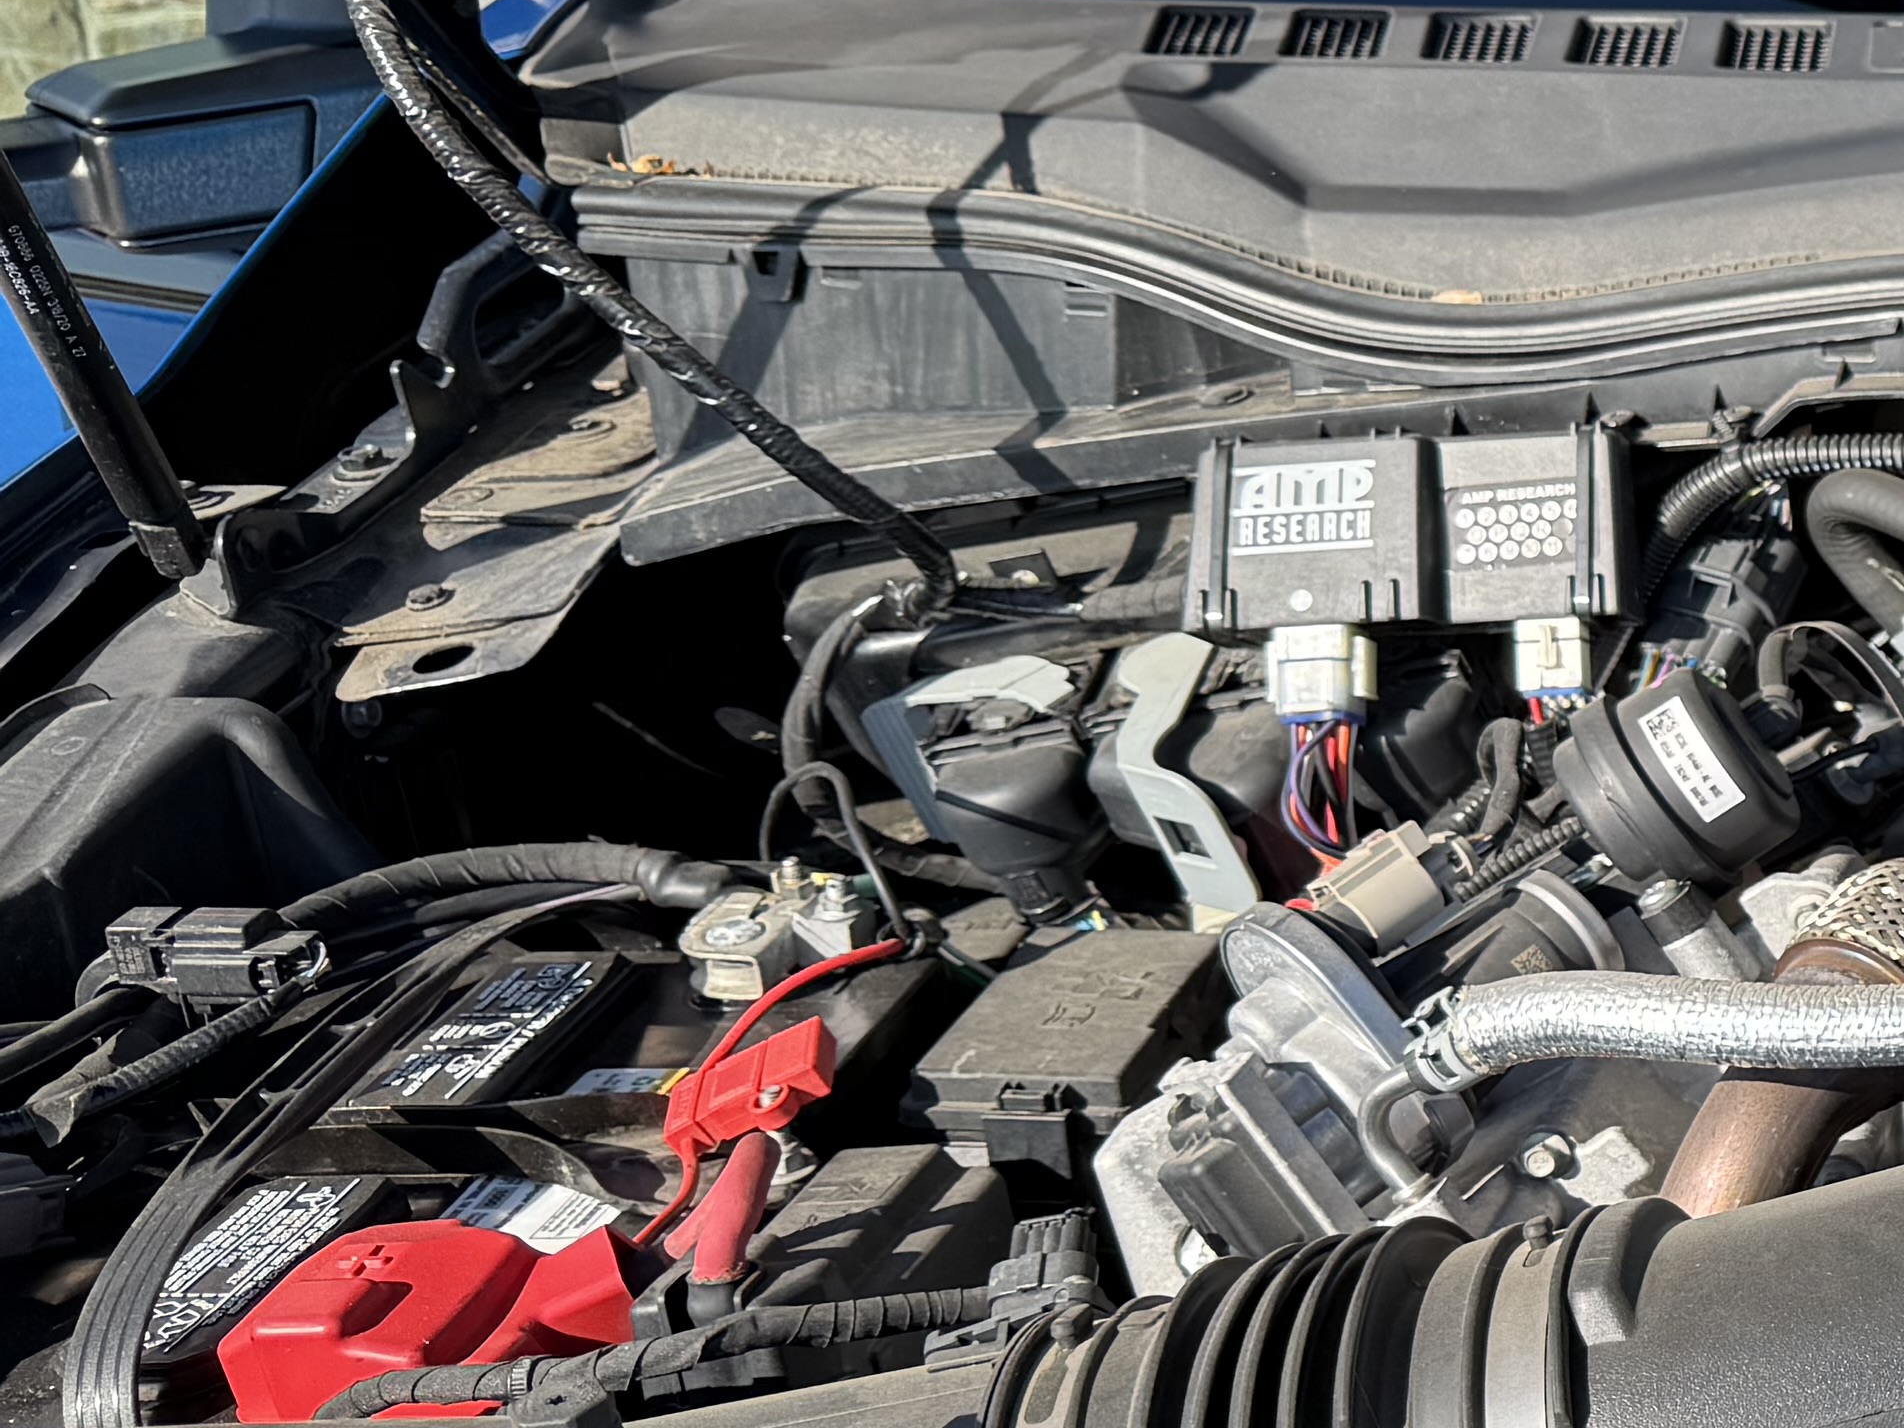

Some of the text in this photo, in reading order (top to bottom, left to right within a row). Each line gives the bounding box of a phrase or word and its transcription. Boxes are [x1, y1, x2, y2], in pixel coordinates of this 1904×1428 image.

[1239, 467, 1375, 509] AMP
[1461, 483, 1576, 506] AMP RESEARCH
[1239, 510, 1372, 547] RESEARCH
